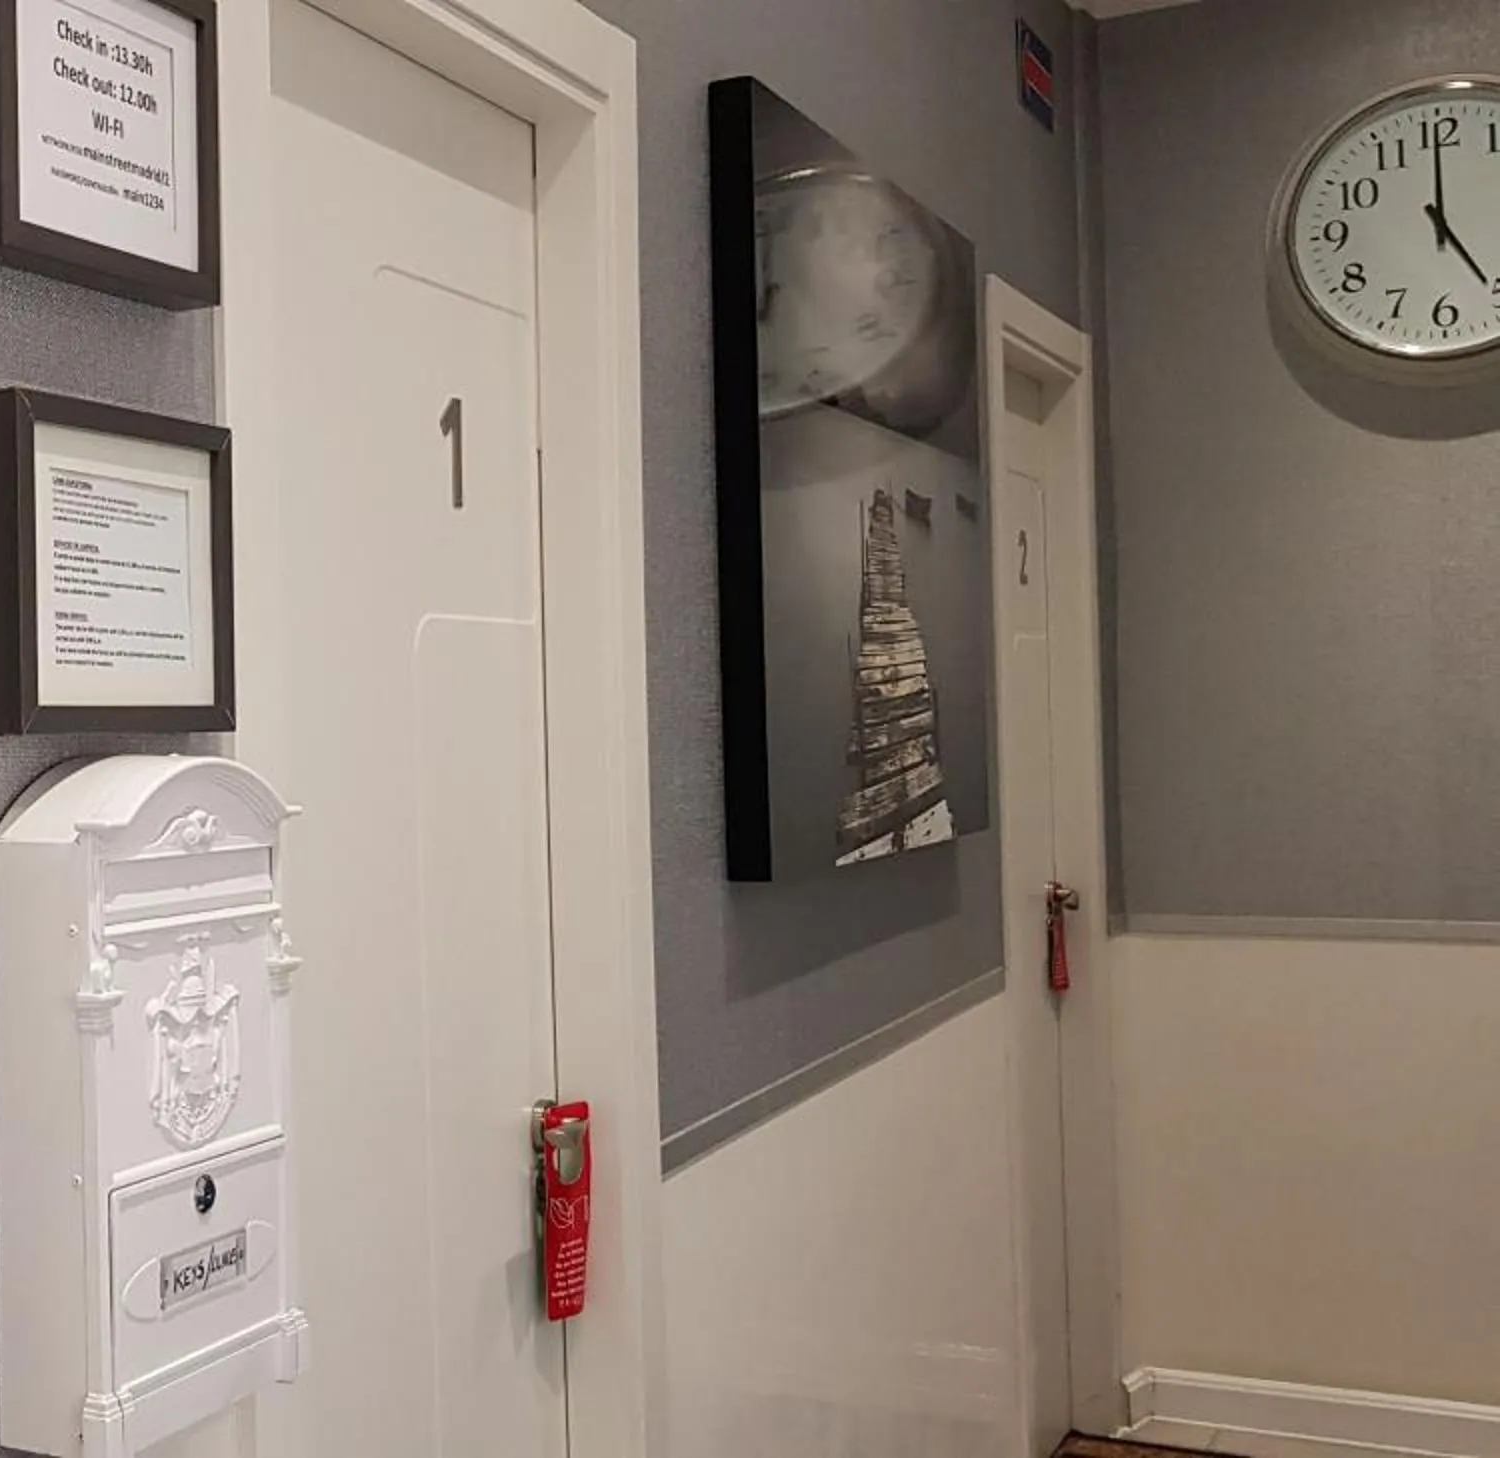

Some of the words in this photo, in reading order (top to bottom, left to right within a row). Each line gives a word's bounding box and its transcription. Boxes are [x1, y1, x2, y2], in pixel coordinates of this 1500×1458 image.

[57, 19, 94, 51] Check
[96, 35, 109, 56] in
[53, 56, 89, 88] Check
[92, 77, 117, 99] out:
[120, 83, 158, 114] 12.00h
[1419, 117, 1460, 149] 12
[1376, 139, 1409, 170] 11
[1340, 178, 1379, 211] 10
[1323, 220, 1349, 252] 9
[1341, 263, 1367, 293] 8
[1386, 286, 1408, 319] 7
[1432, 292, 1459, 328] 6
[440, 397, 464, 509] 1
